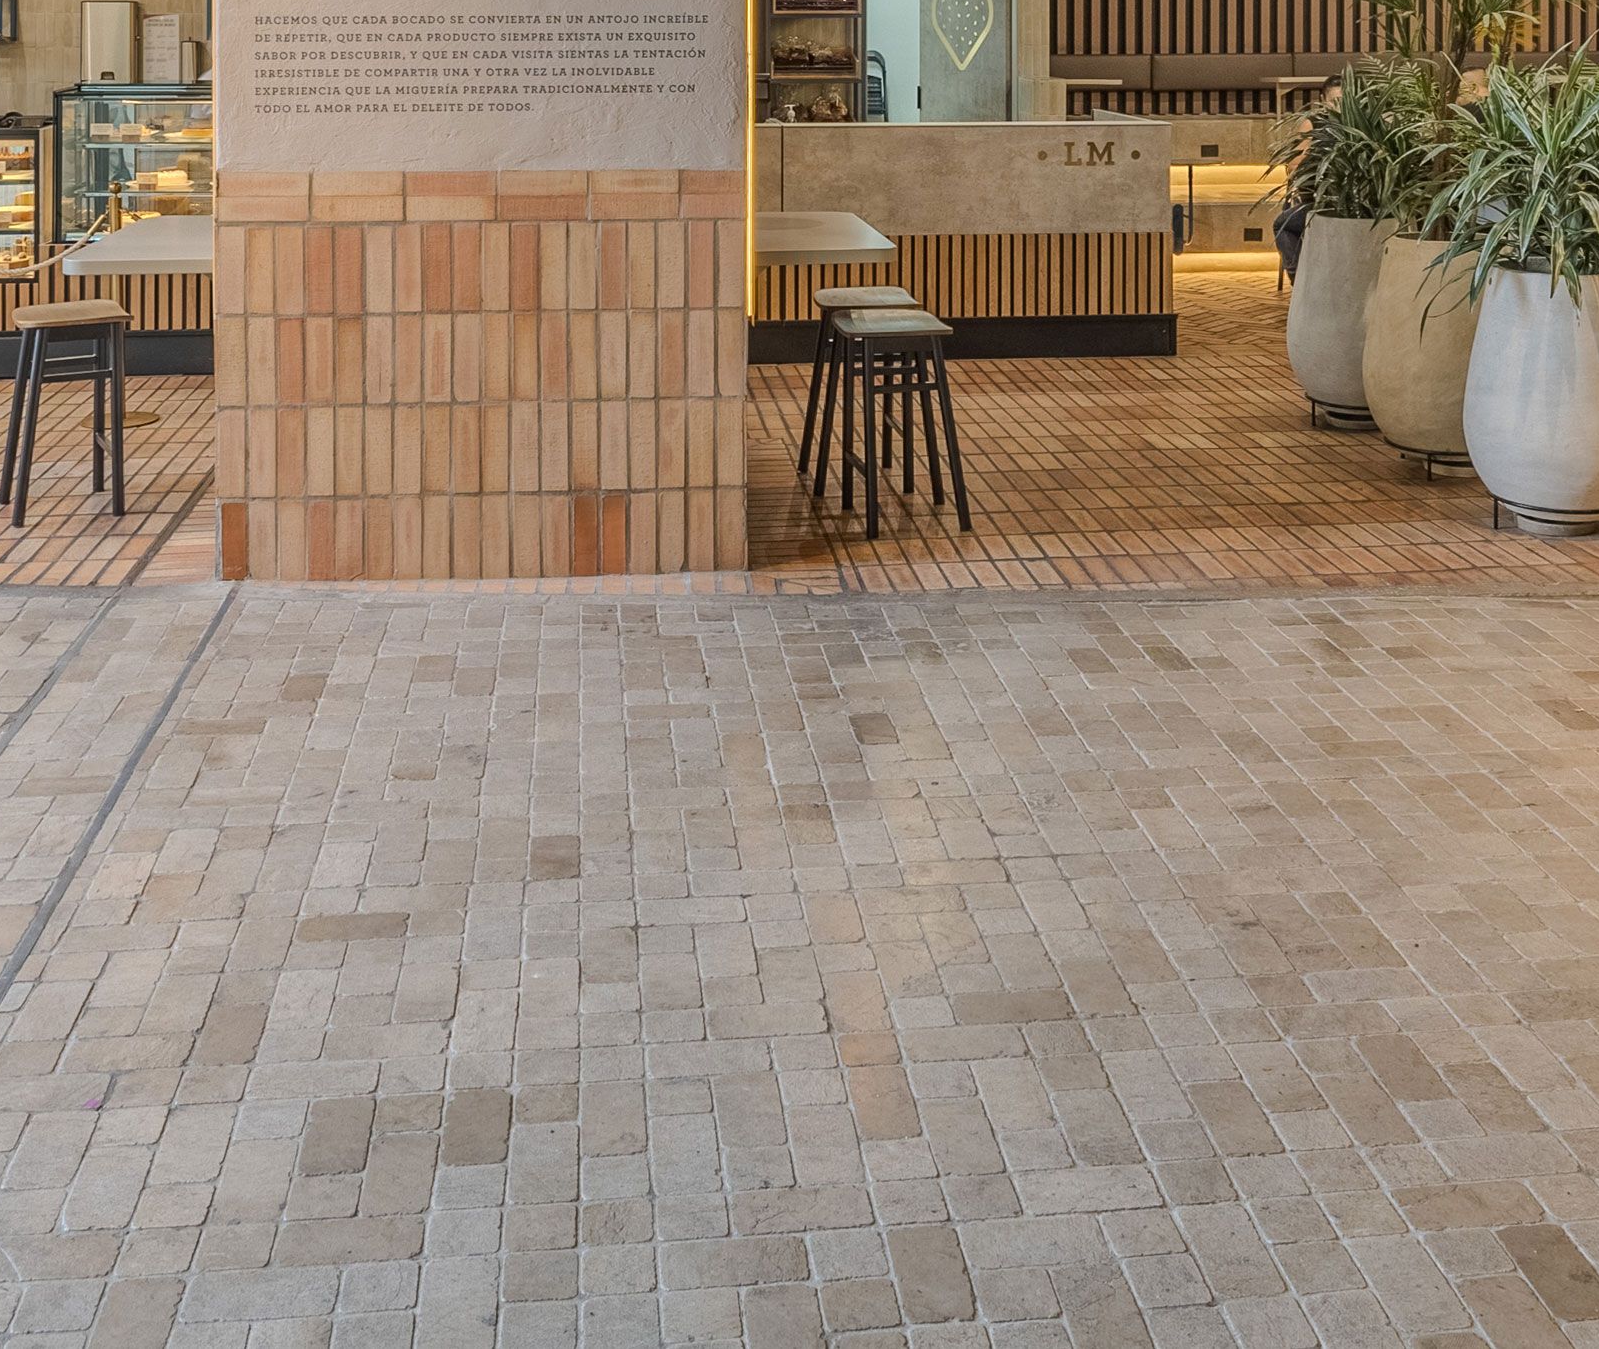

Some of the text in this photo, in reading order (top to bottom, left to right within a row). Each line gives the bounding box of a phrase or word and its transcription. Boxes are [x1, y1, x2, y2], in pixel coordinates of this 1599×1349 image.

[254, 11, 709, 27] HACEMOS QUE CADA BOCADO SE CONVIERTA EN UN ANTOJO INCREÍBLE
[254, 31, 696, 45] DE REPETIR, QUE EN CADA PRODUCTO SIEMPRE EXISTA UN EXQUISITO
[254, 46, 706, 62] SABOR POR DESCUBRIR, Y QUE EN CADA VISITA SIENTAS LA TENTACIÓN
[254, 66, 656, 78] IRRESISTIBLE DE COMPARTIR UNA Y OTRA VEZ LA INOLVIDABLE
[254, 82, 696, 97] EXPERIENCIA QUE LA MIGUERÍA PREPARA TRADICIONALMENTE Y CON
[254, 103, 535, 113] TODO EL AMOR PARA EL DELEITE DE TODOS.
[1063, 141, 1116, 167] LM
